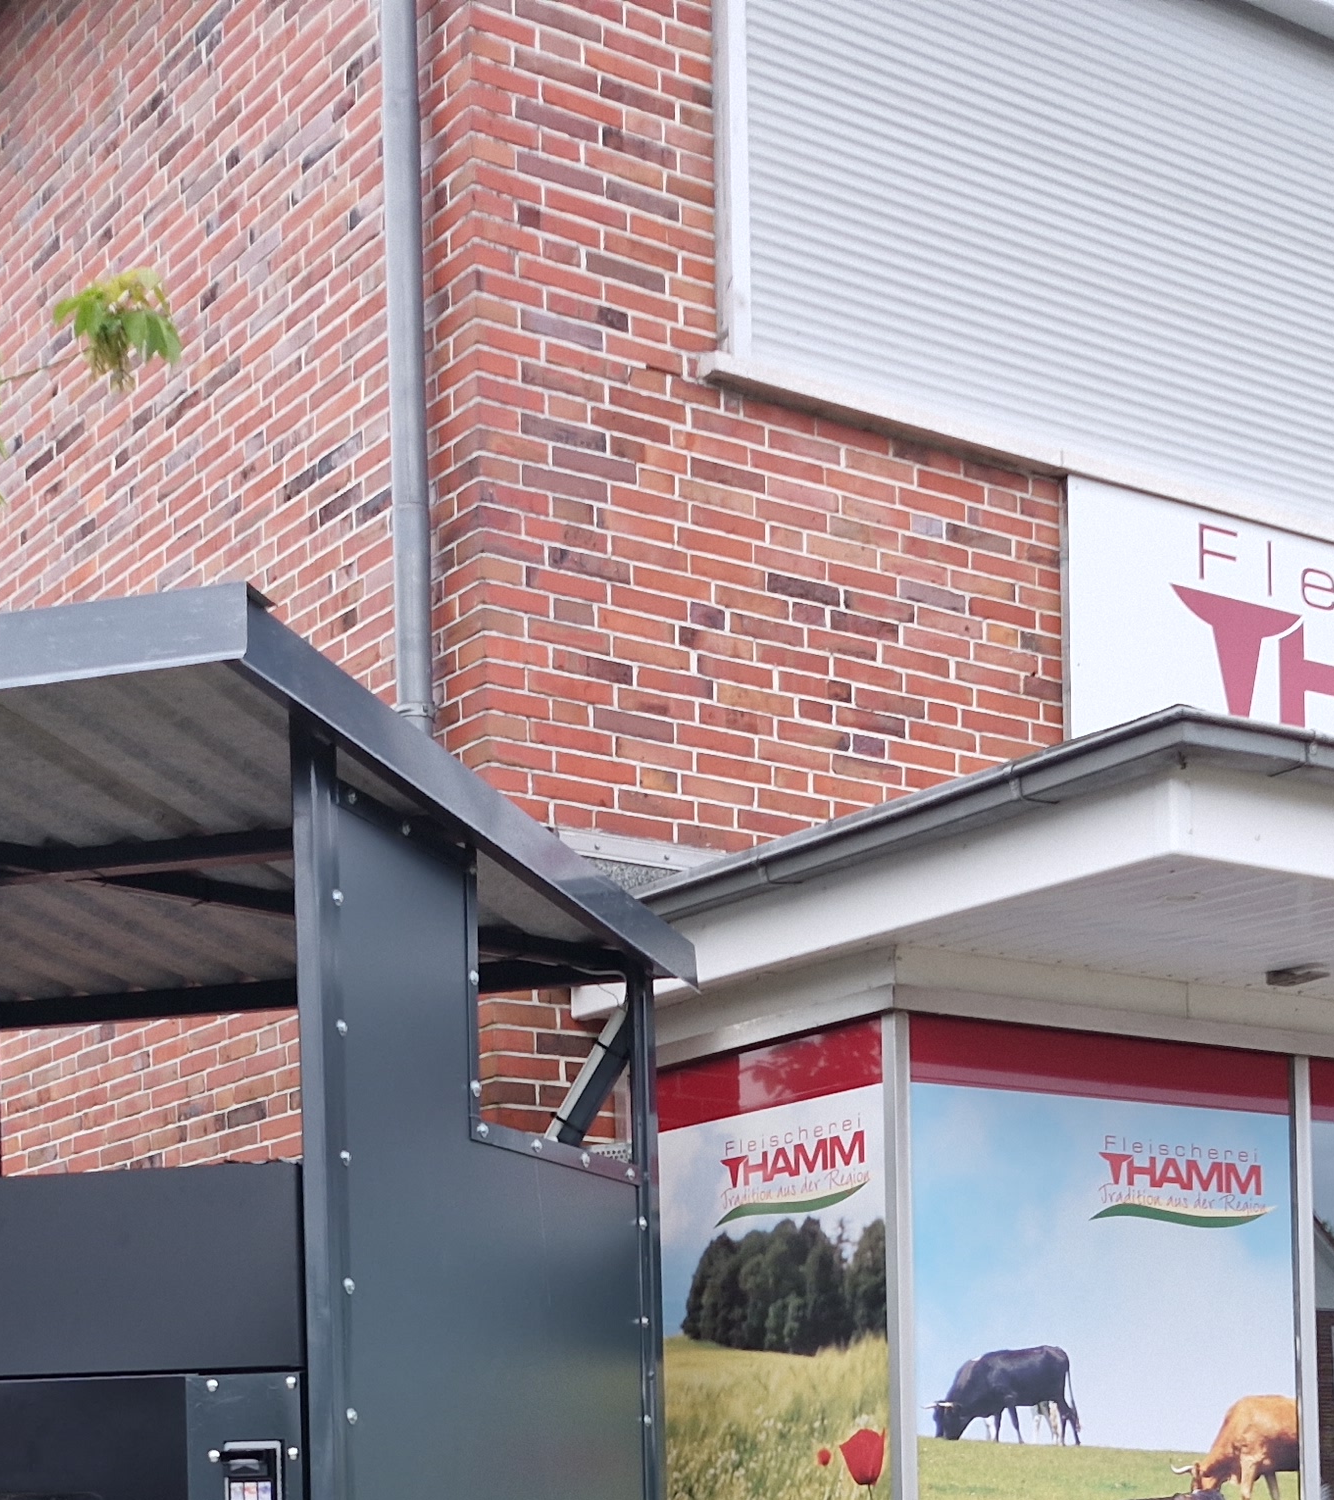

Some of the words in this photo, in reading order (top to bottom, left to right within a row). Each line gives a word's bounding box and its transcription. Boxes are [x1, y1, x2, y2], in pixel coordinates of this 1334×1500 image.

[725, 1112, 861, 1156] Fleischerei
[1104, 1134, 1258, 1162] Fleischerei
[720, 1129, 865, 1188] THAMM
[1098, 1151, 1262, 1195] THAMM
[721, 1185, 772, 1209] Tradition
[776, 1186, 797, 1199] aus
[800, 1176, 820, 1194] der
[824, 1168, 872, 1188] Region
[1098, 1183, 1161, 1205] Tradition
[1168, 1195, 1188, 1209] aus
[1193, 1193, 1213, 1211] der
[1218, 1194, 1267, 1216] Region
